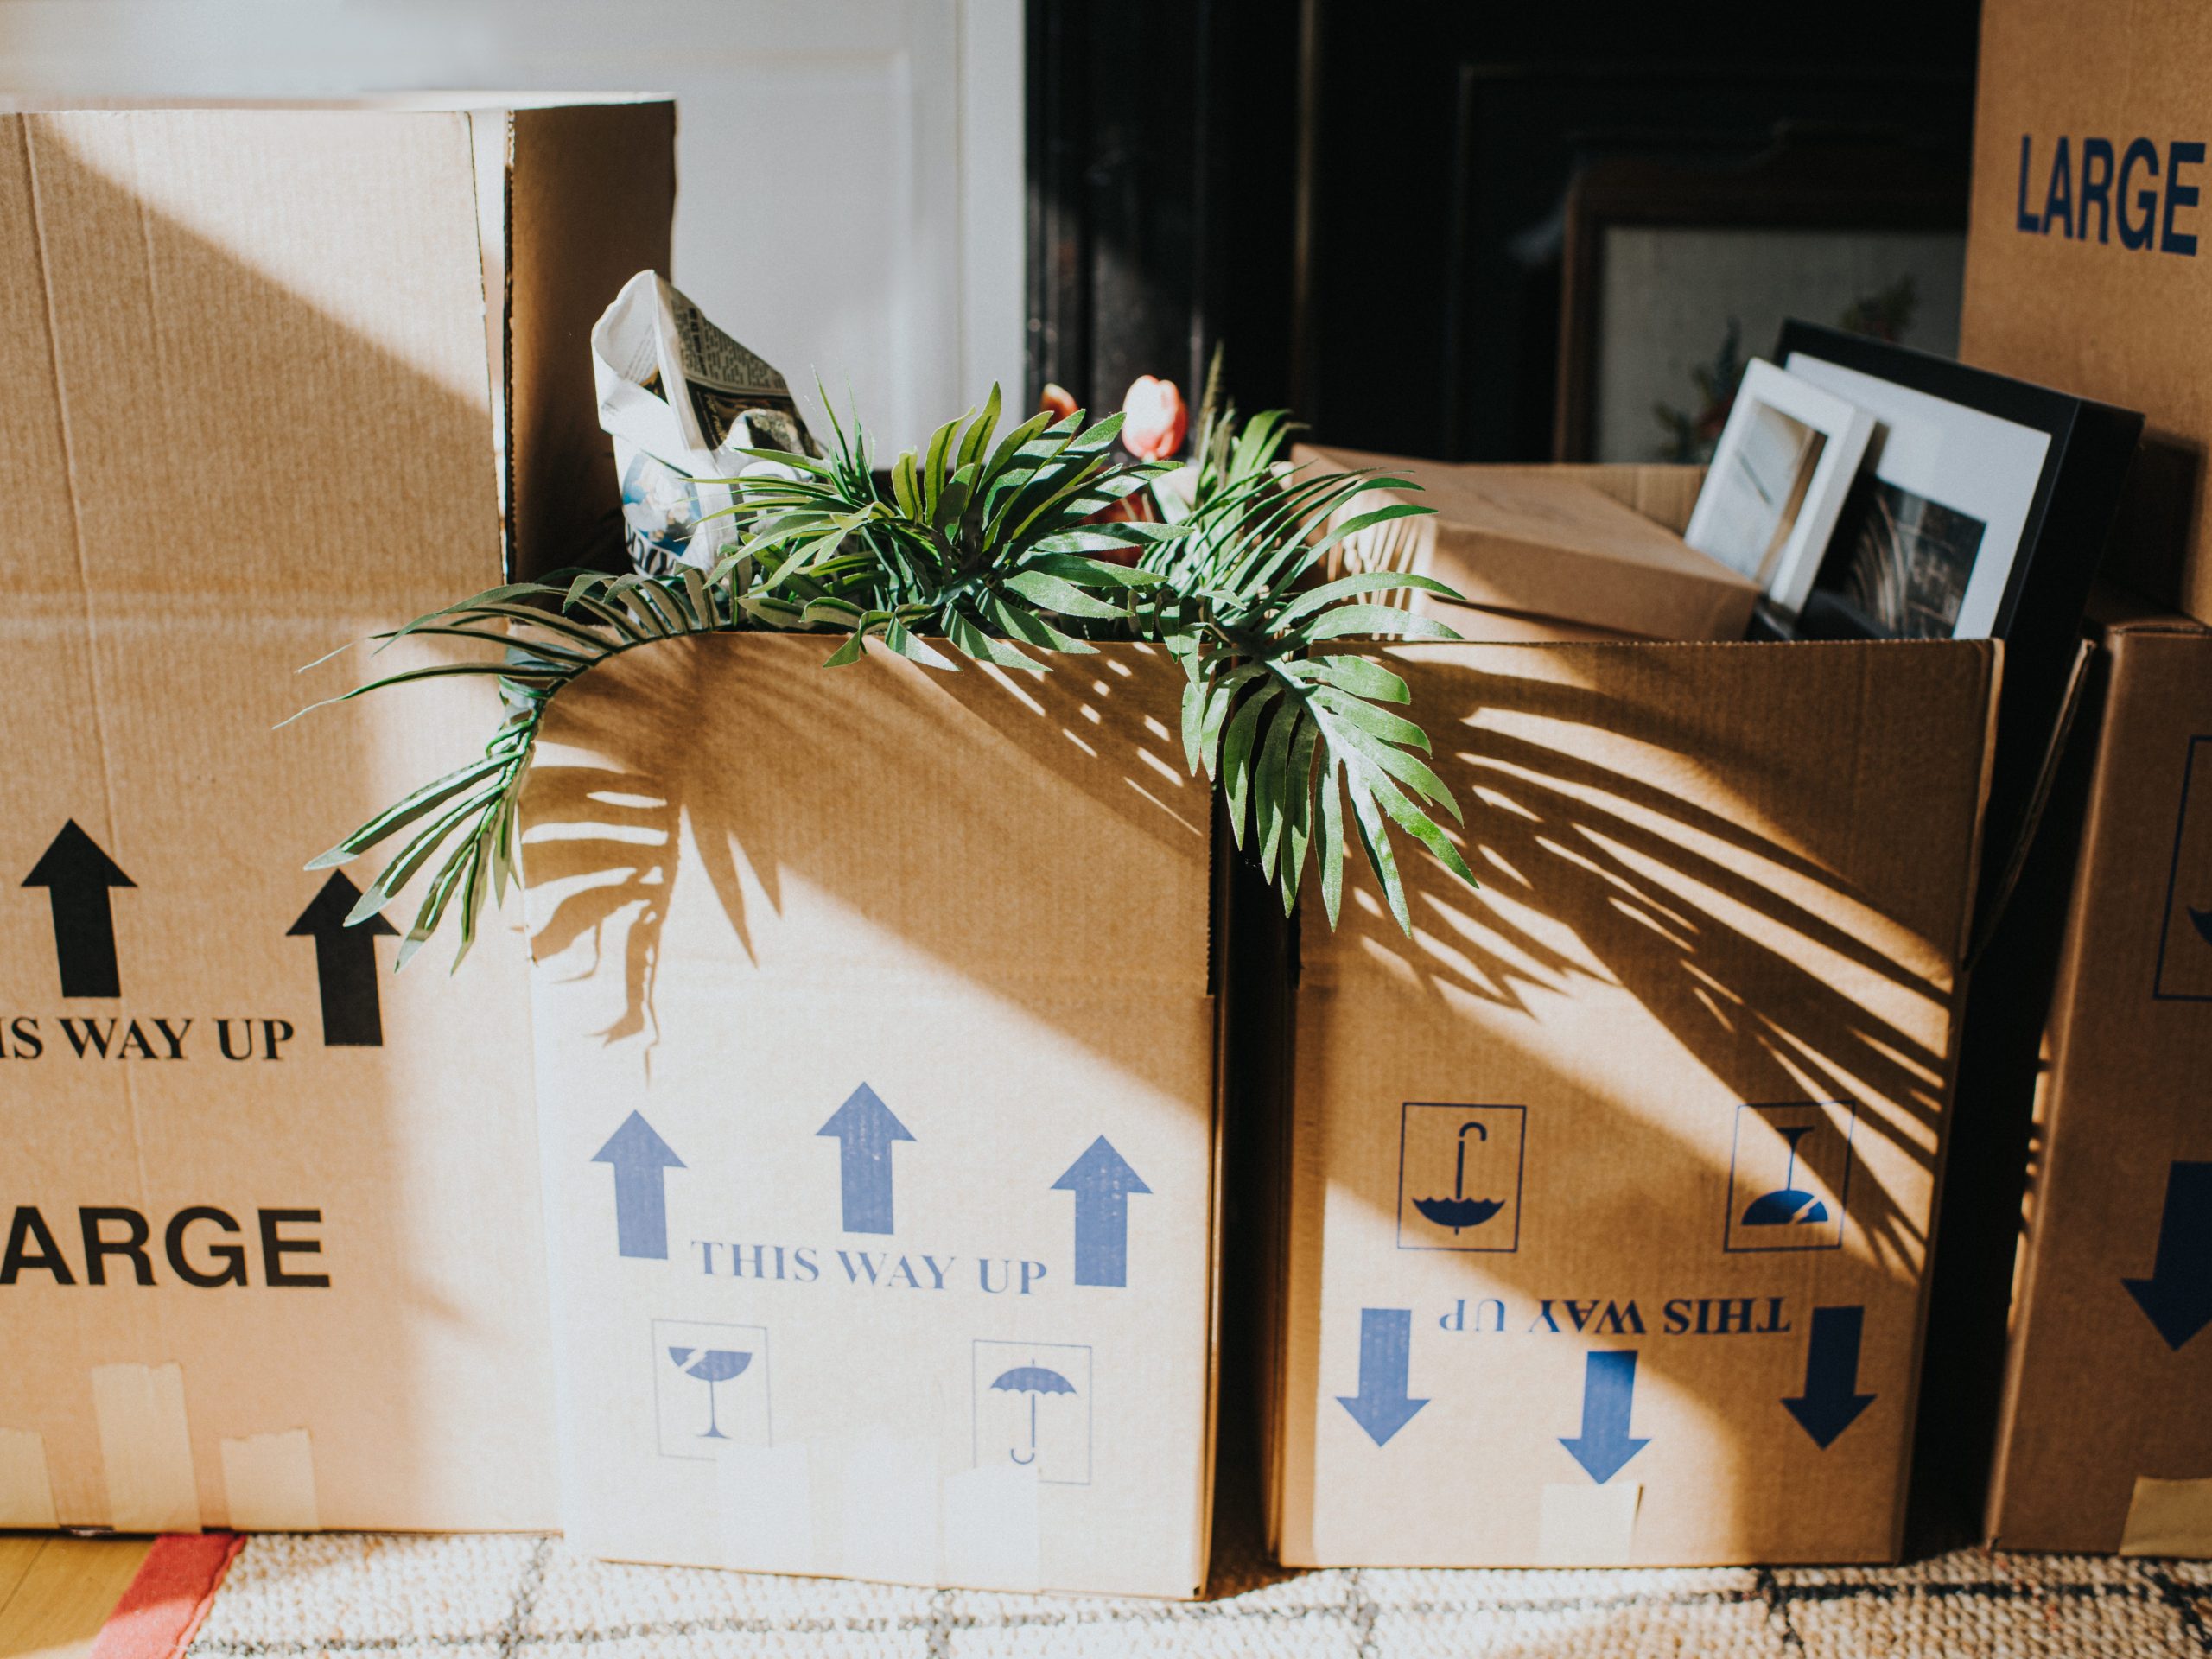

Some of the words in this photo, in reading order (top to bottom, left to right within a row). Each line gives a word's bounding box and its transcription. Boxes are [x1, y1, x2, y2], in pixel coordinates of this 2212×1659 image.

[2017, 134, 2207, 257] LARGE
[57, 1018, 192, 1060] WAY
[213, 1018, 295, 1061] UP
[0, 1205, 331, 1287] ARGE
[691, 1241, 819, 1282] THIS
[836, 1250, 957, 1290] WAY
[977, 1258, 1047, 1294] UP
[1439, 1299, 1505, 1332] UP
[1529, 1299, 1646, 1334] WAY
[1663, 1297, 1791, 1334] THIS
